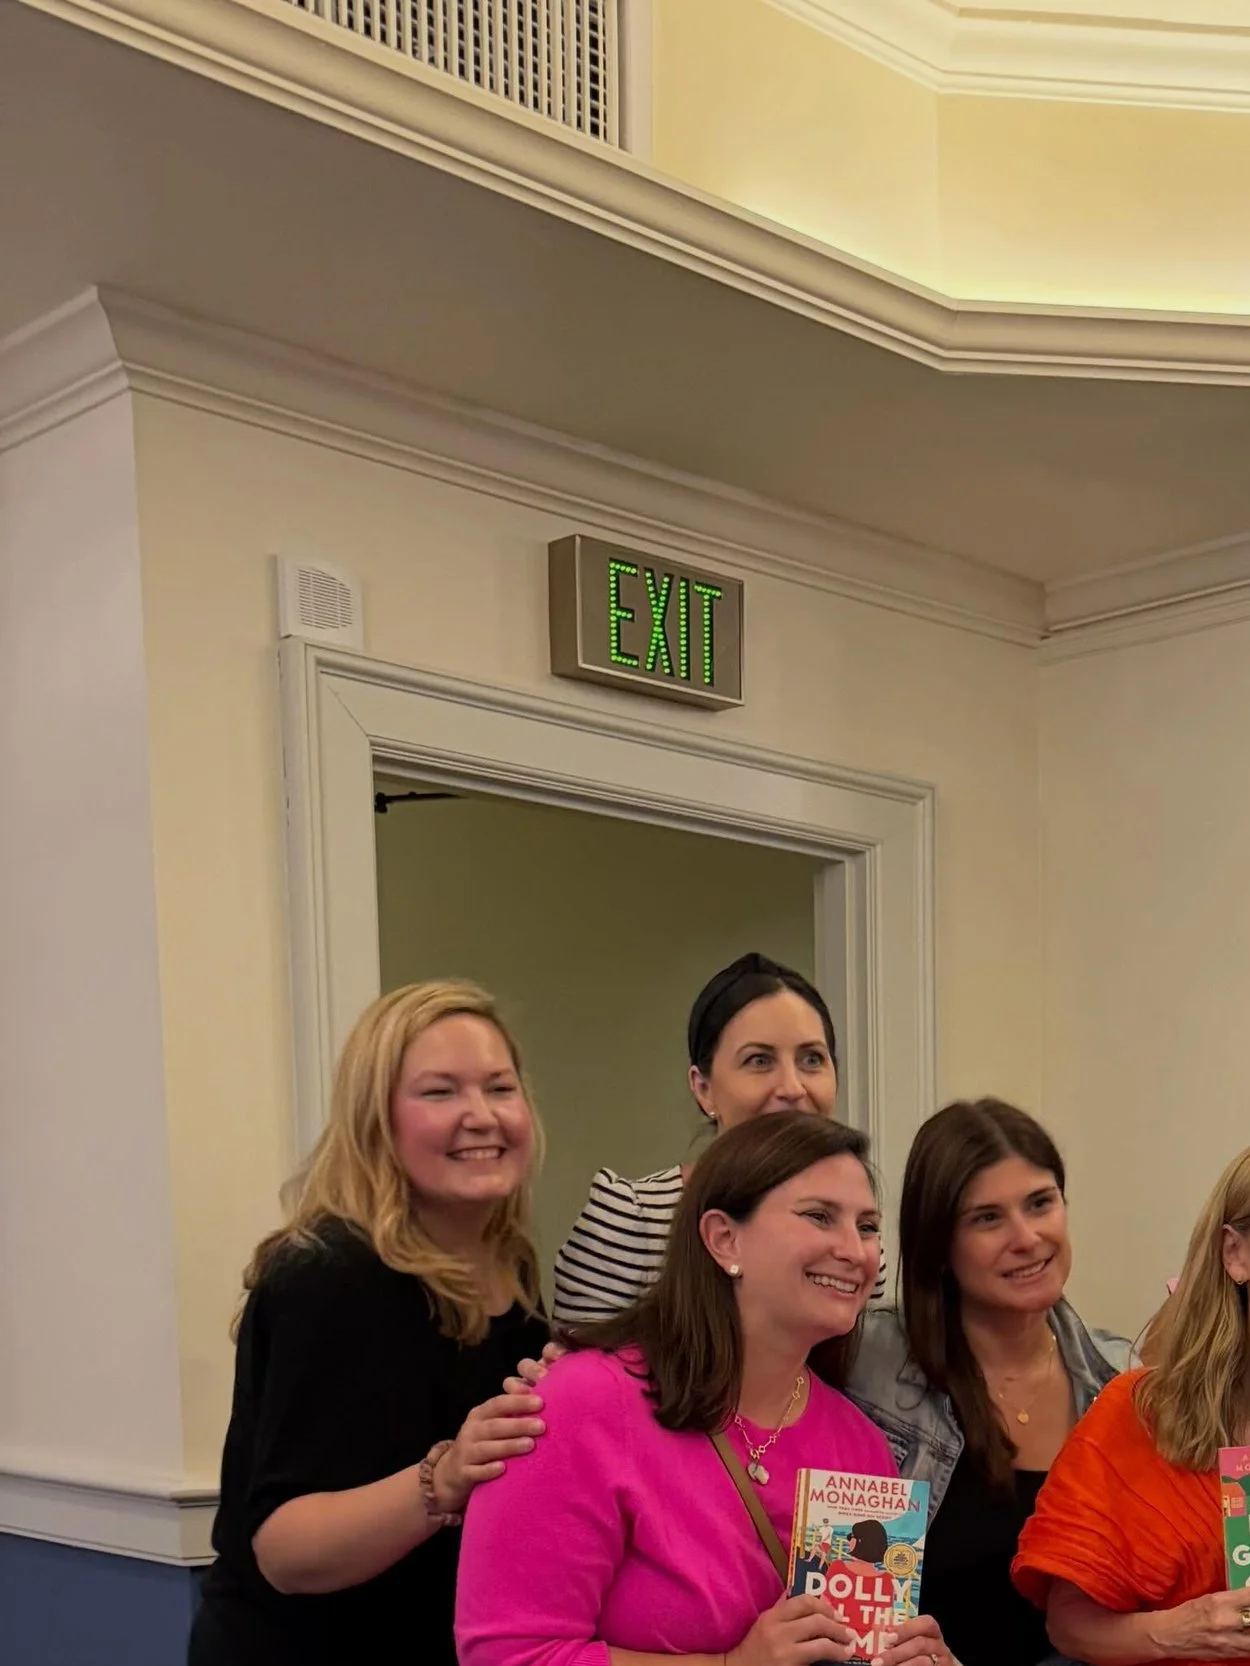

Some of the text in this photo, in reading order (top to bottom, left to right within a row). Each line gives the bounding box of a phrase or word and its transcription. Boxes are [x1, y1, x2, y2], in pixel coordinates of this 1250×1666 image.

[609, 557, 722, 687] EXIT
[825, 1475, 907, 1496] ANNABEL
[810, 1489, 920, 1512] MONAGHAN
[805, 1571, 912, 1602] DOLLY
[859, 1605, 906, 1626] THE
